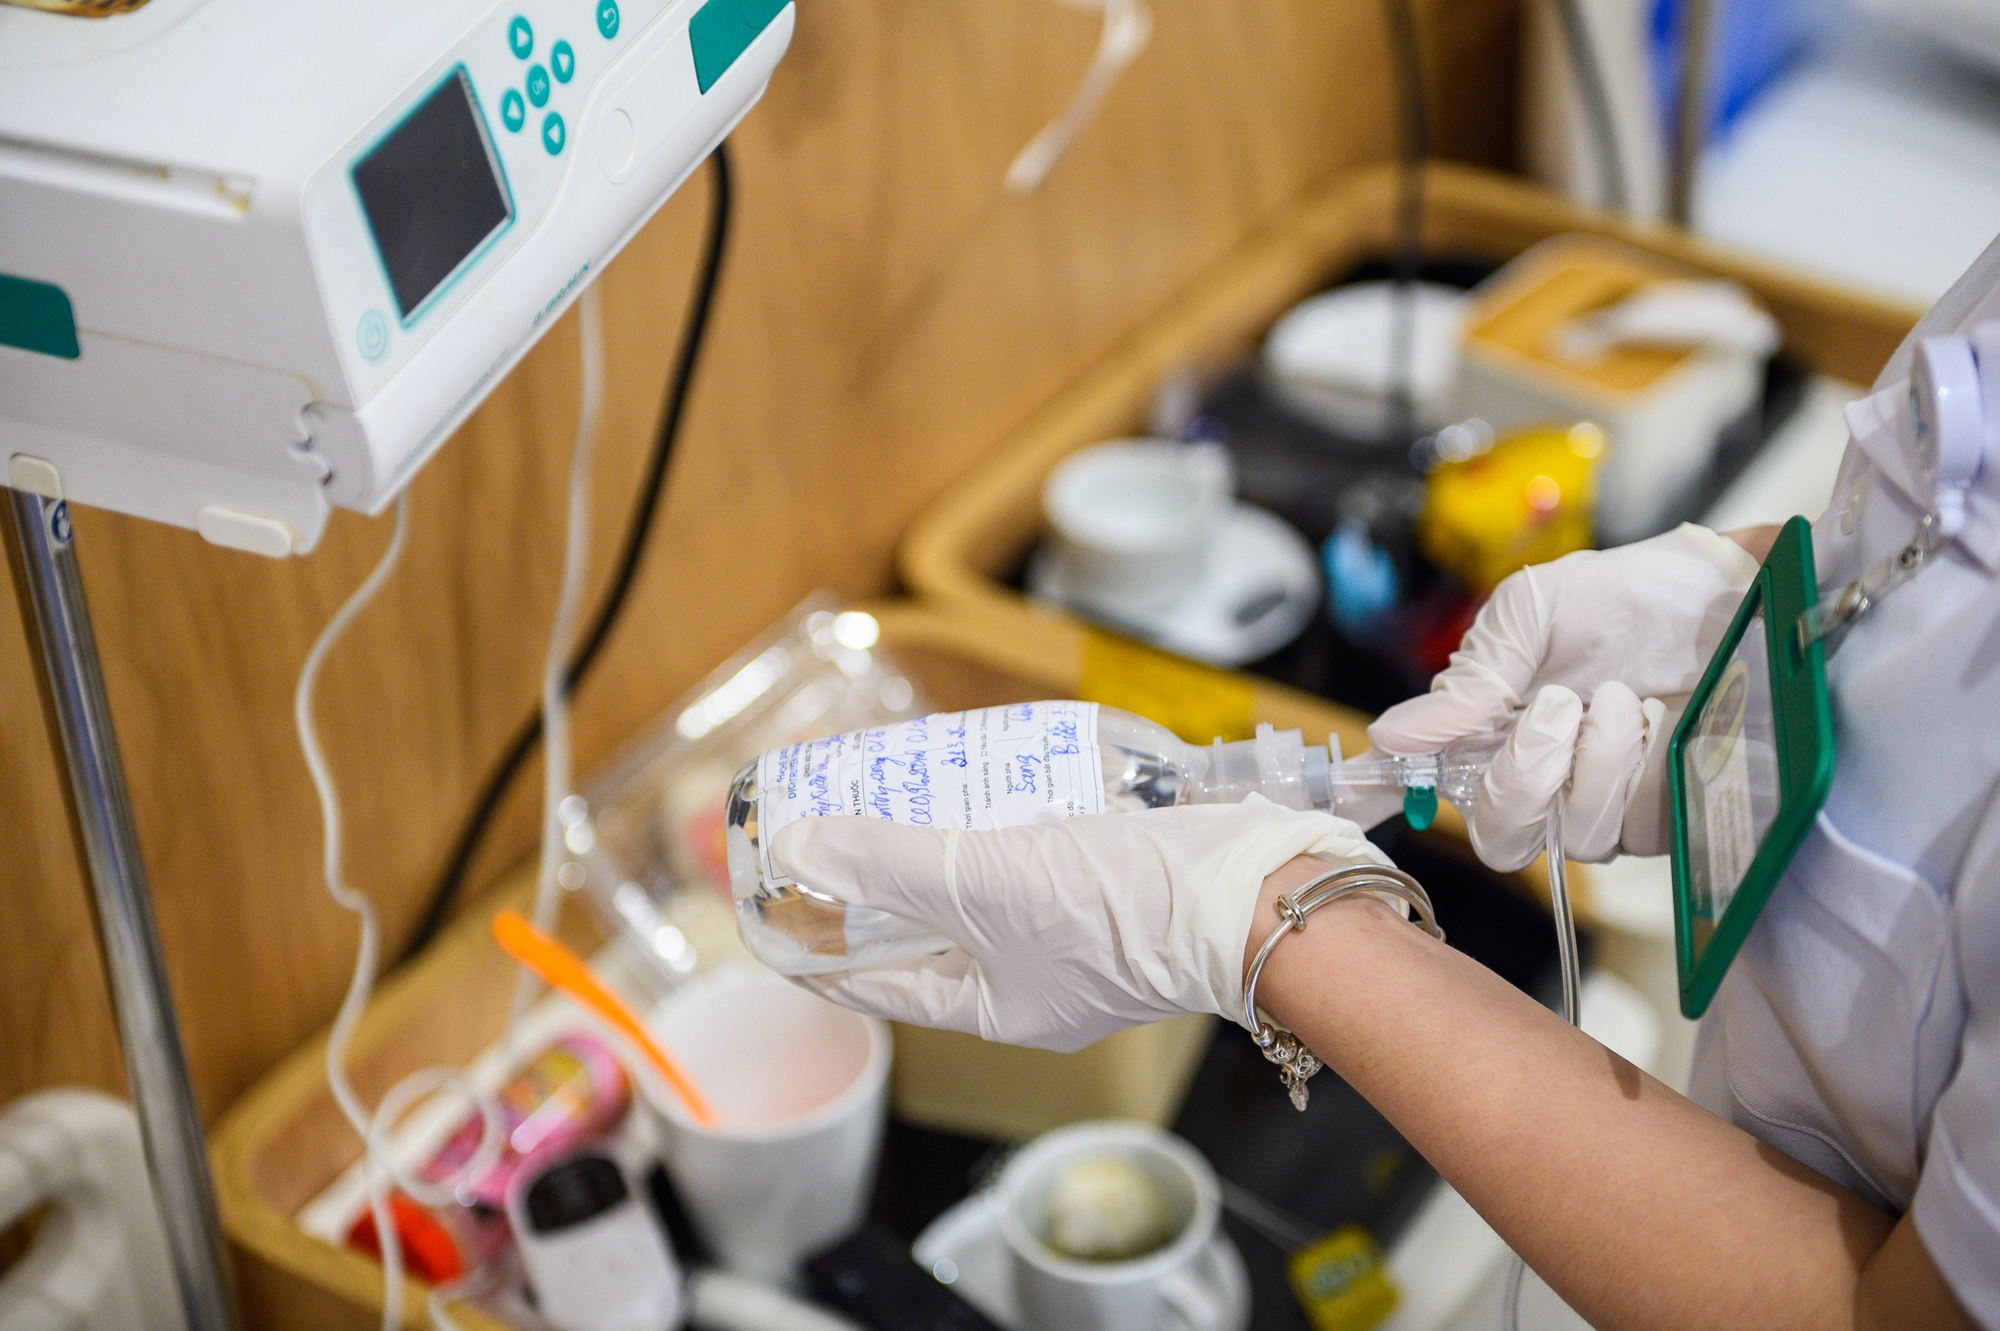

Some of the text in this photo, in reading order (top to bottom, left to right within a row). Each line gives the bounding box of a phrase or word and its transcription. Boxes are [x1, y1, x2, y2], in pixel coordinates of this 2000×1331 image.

[531, 75, 546, 95] OK
[1043, 751, 1051, 762] đầu
[981, 761, 990, 776] sáng
[1044, 763, 1052, 773] bắt
[982, 777, 990, 789] ánh
[1004, 762, 1014, 794] Người pha
[1046, 774, 1055, 788] gian
[787, 782, 798, 799] DỊC
[850, 780, 861, 806] THUỐC
[1046, 789, 1054, 803] Thời
[961, 783, 973, 829] Thời gian pha:
[983, 790, 992, 809] Tránh
